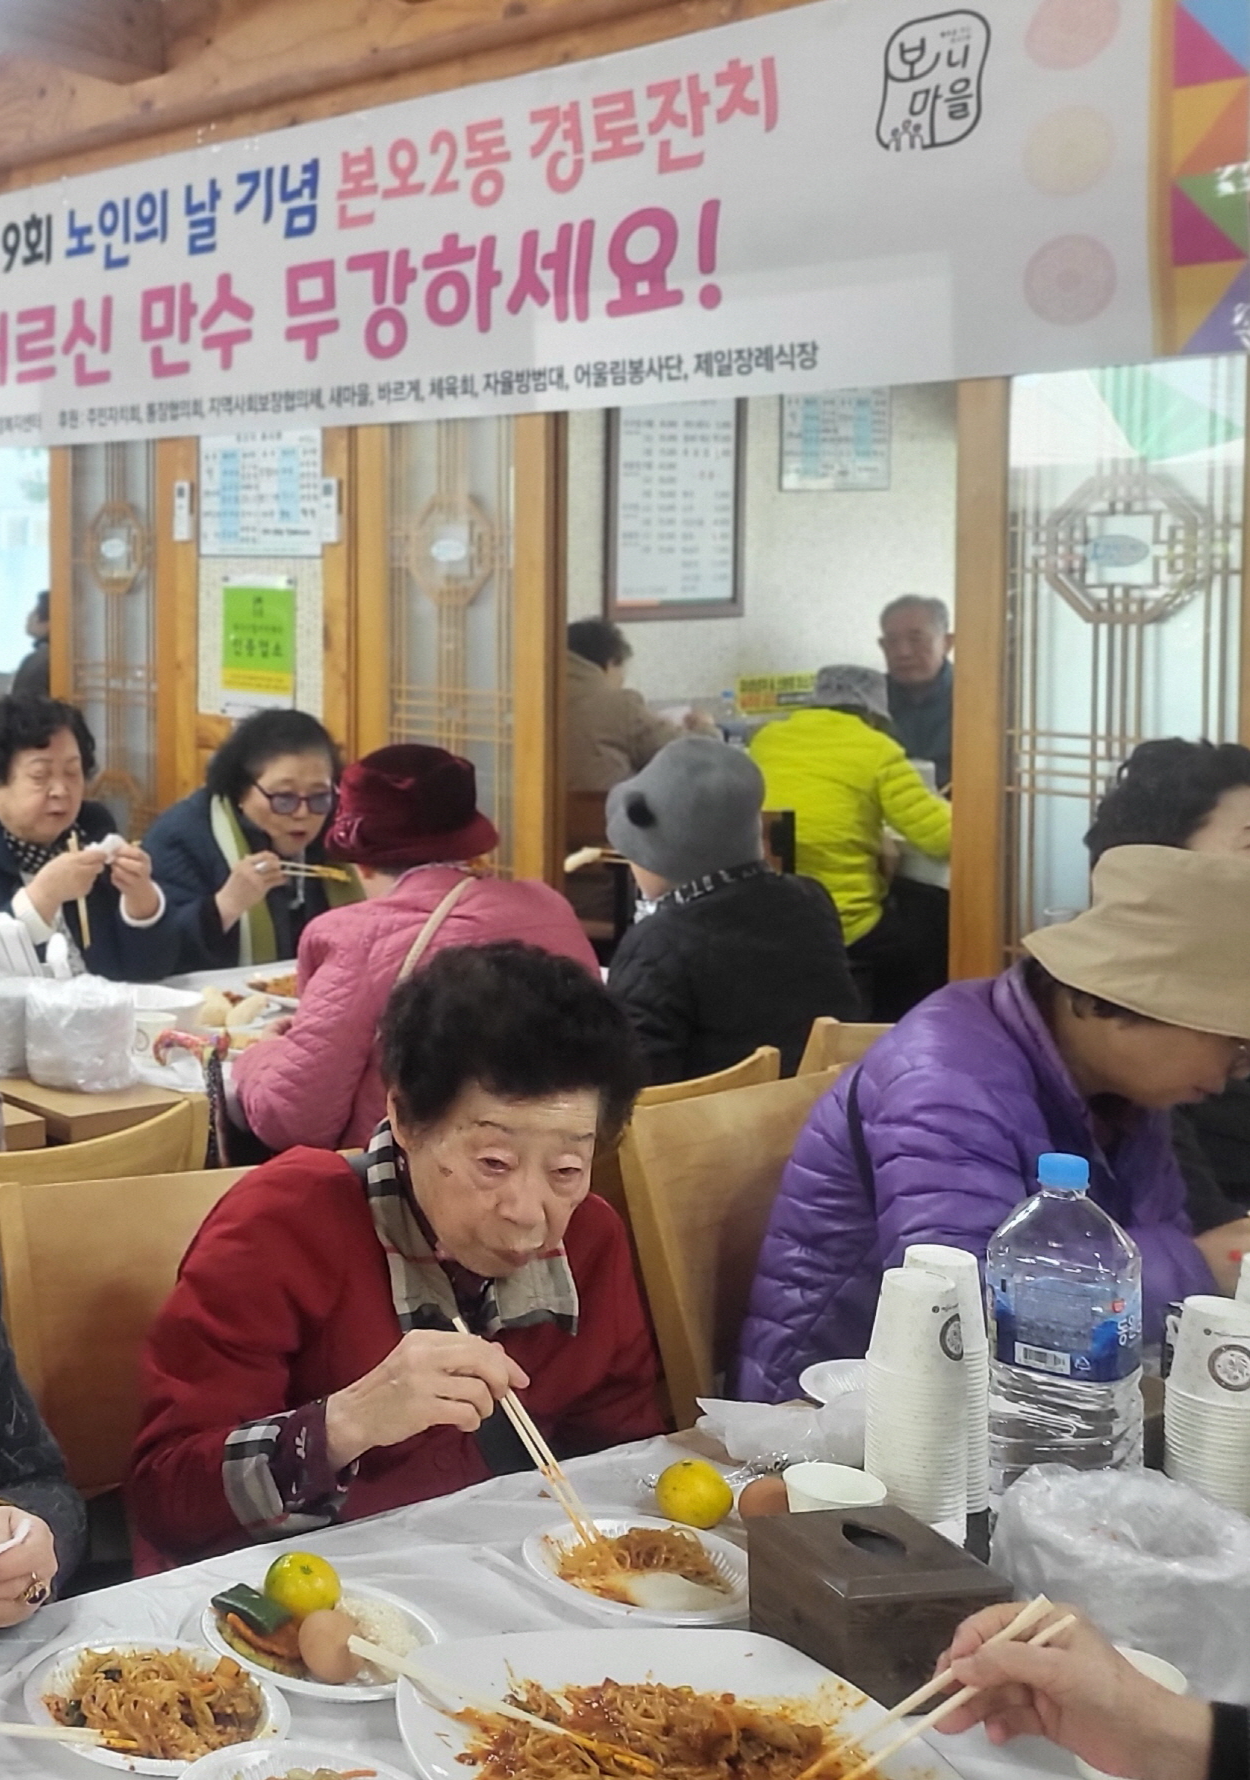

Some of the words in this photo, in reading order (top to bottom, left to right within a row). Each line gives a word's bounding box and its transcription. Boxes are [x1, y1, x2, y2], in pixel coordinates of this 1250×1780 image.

[64, 188, 169, 271] 노인의
[184, 177, 222, 257] 날
[234, 157, 320, 240] 기념
[336, 118, 511, 230] 본오2동
[529, 56, 778, 194] 경로잔치
[907, 77, 974, 141] 마을
[140, 272, 255, 380] 만수
[284, 198, 722, 362] 무강하세요!
[208, 387, 326, 417] 지역사회보장협의체,
[328, 382, 375, 408] 새마을,
[377, 378, 425, 404] 바르게,
[428, 374, 479, 401] 체육회,
[482, 365, 570, 397] 자율방범대,
[574, 353, 689, 389] 어울림봉사단,
[693, 340, 820, 379] 제일장례식장
